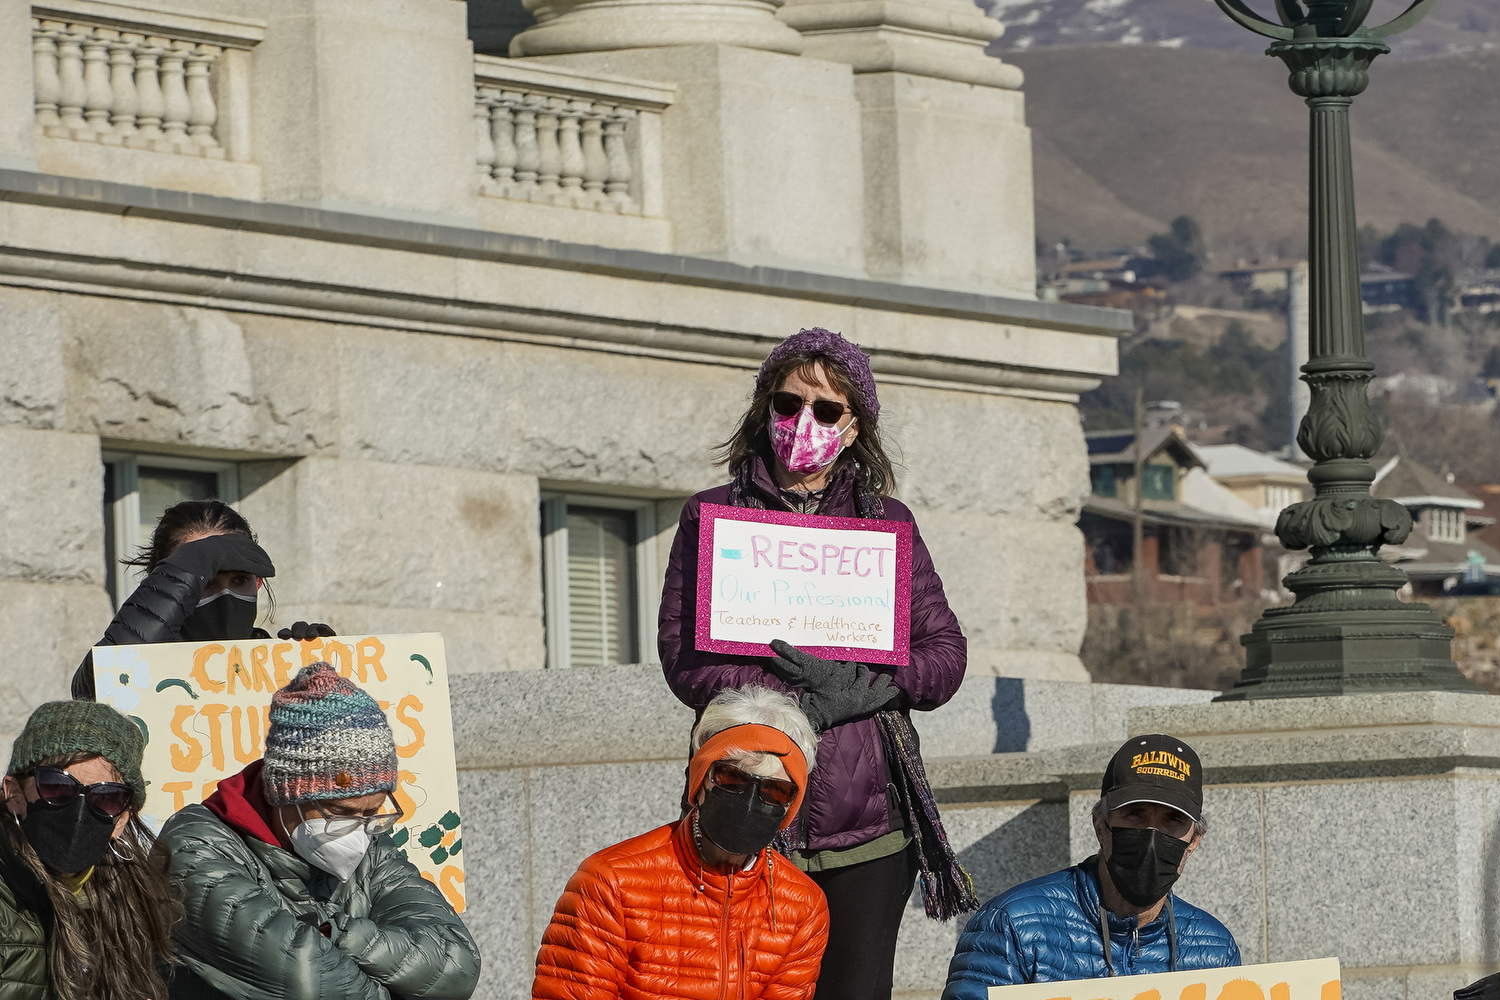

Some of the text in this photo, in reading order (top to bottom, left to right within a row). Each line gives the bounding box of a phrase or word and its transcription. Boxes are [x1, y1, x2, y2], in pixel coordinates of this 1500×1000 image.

[750, 534, 894, 577] RESPECT
[720, 574, 891, 611] Our Professional
[713, 610, 782, 627] Teachers
[803, 615, 882, 632] Healthcare
[189, 642, 294, 695] CARE
[1131, 751, 1190, 776] BALDWIN
[1136, 767, 1185, 781] SQUIRRELS
